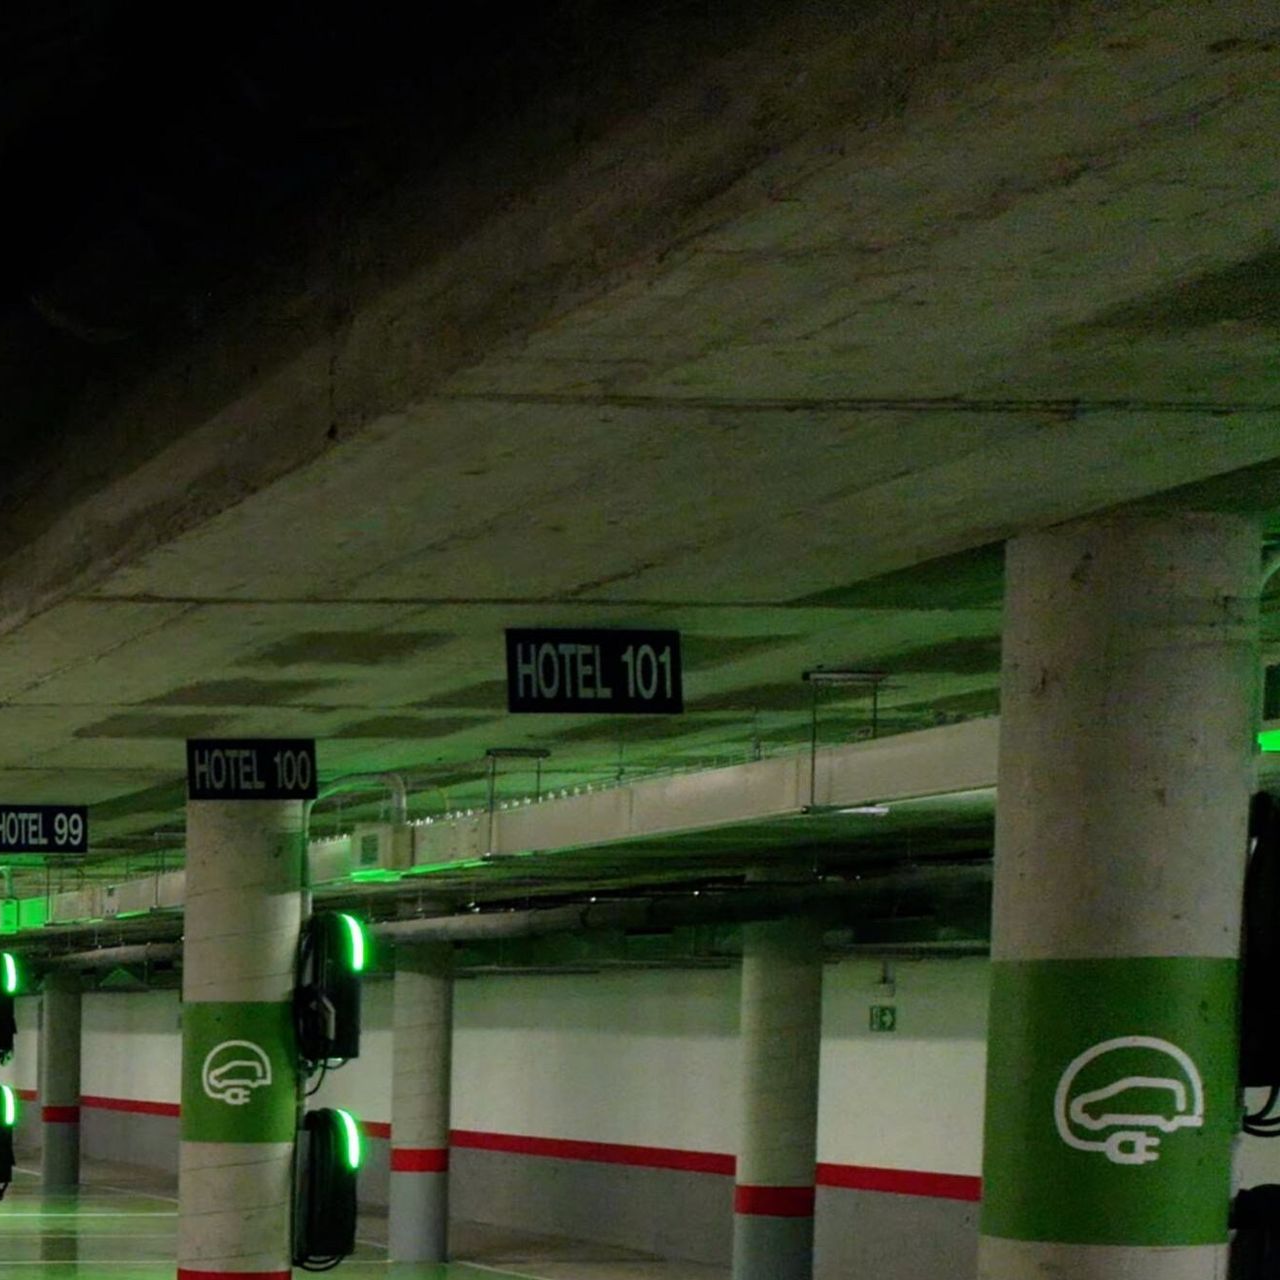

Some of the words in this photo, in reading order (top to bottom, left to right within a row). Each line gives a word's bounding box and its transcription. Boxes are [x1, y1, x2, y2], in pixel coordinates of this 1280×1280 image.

[516, 642, 613, 700] HOTEL
[621, 644, 673, 700] 101
[194, 748, 266, 790] HOTEL
[273, 749, 311, 790] 100
[54, 812, 83, 846] 99
